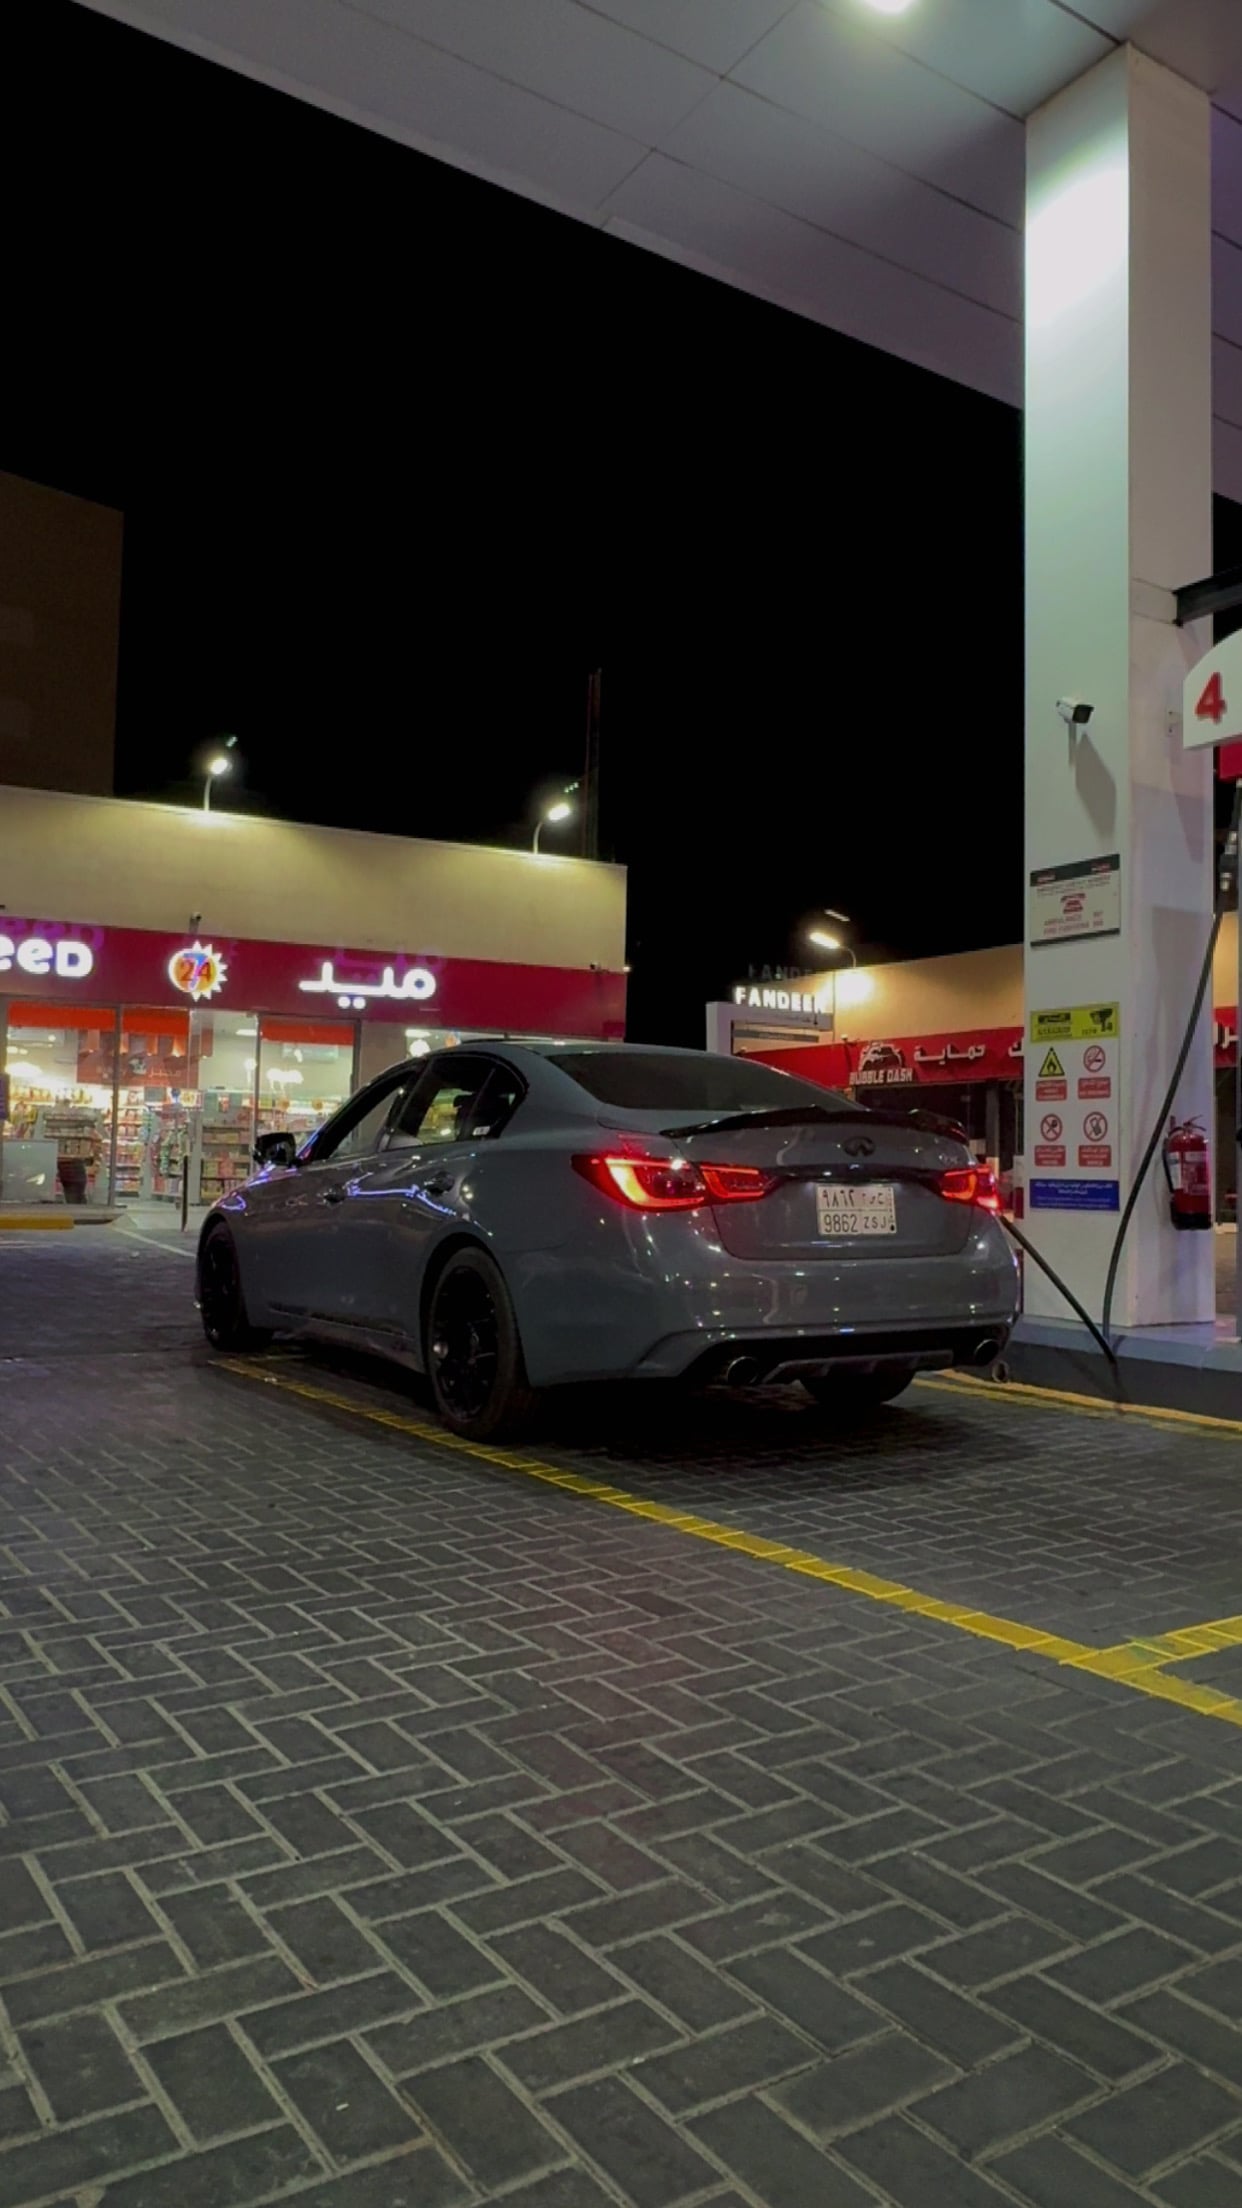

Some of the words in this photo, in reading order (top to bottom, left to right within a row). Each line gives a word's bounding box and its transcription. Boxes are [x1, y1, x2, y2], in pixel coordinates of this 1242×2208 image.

[1194, 671, 1227, 725] 4
[886, 1067, 913, 1083] DASH
[824, 1213, 858, 1233] 9862
